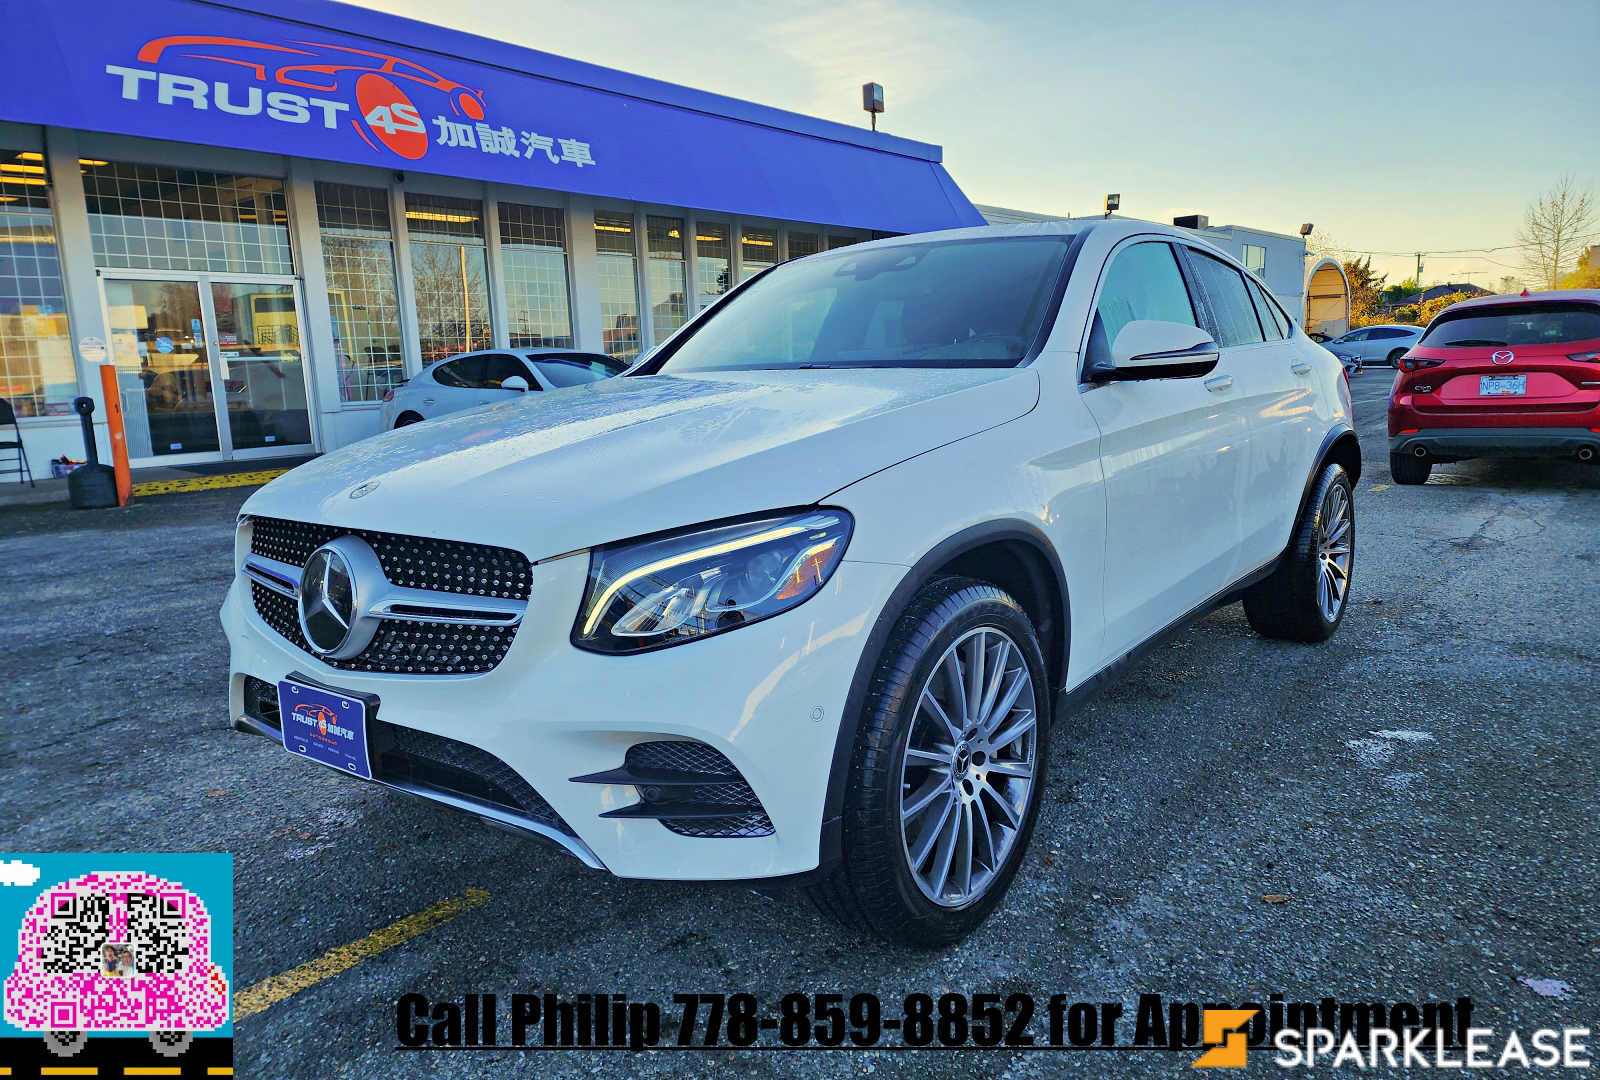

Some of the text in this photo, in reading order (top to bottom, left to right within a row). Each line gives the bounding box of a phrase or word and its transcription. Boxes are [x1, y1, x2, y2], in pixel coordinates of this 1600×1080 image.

[106, 65, 596, 167] TRUST 4S 加誠汽車
[291, 712, 317, 727] TRUST
